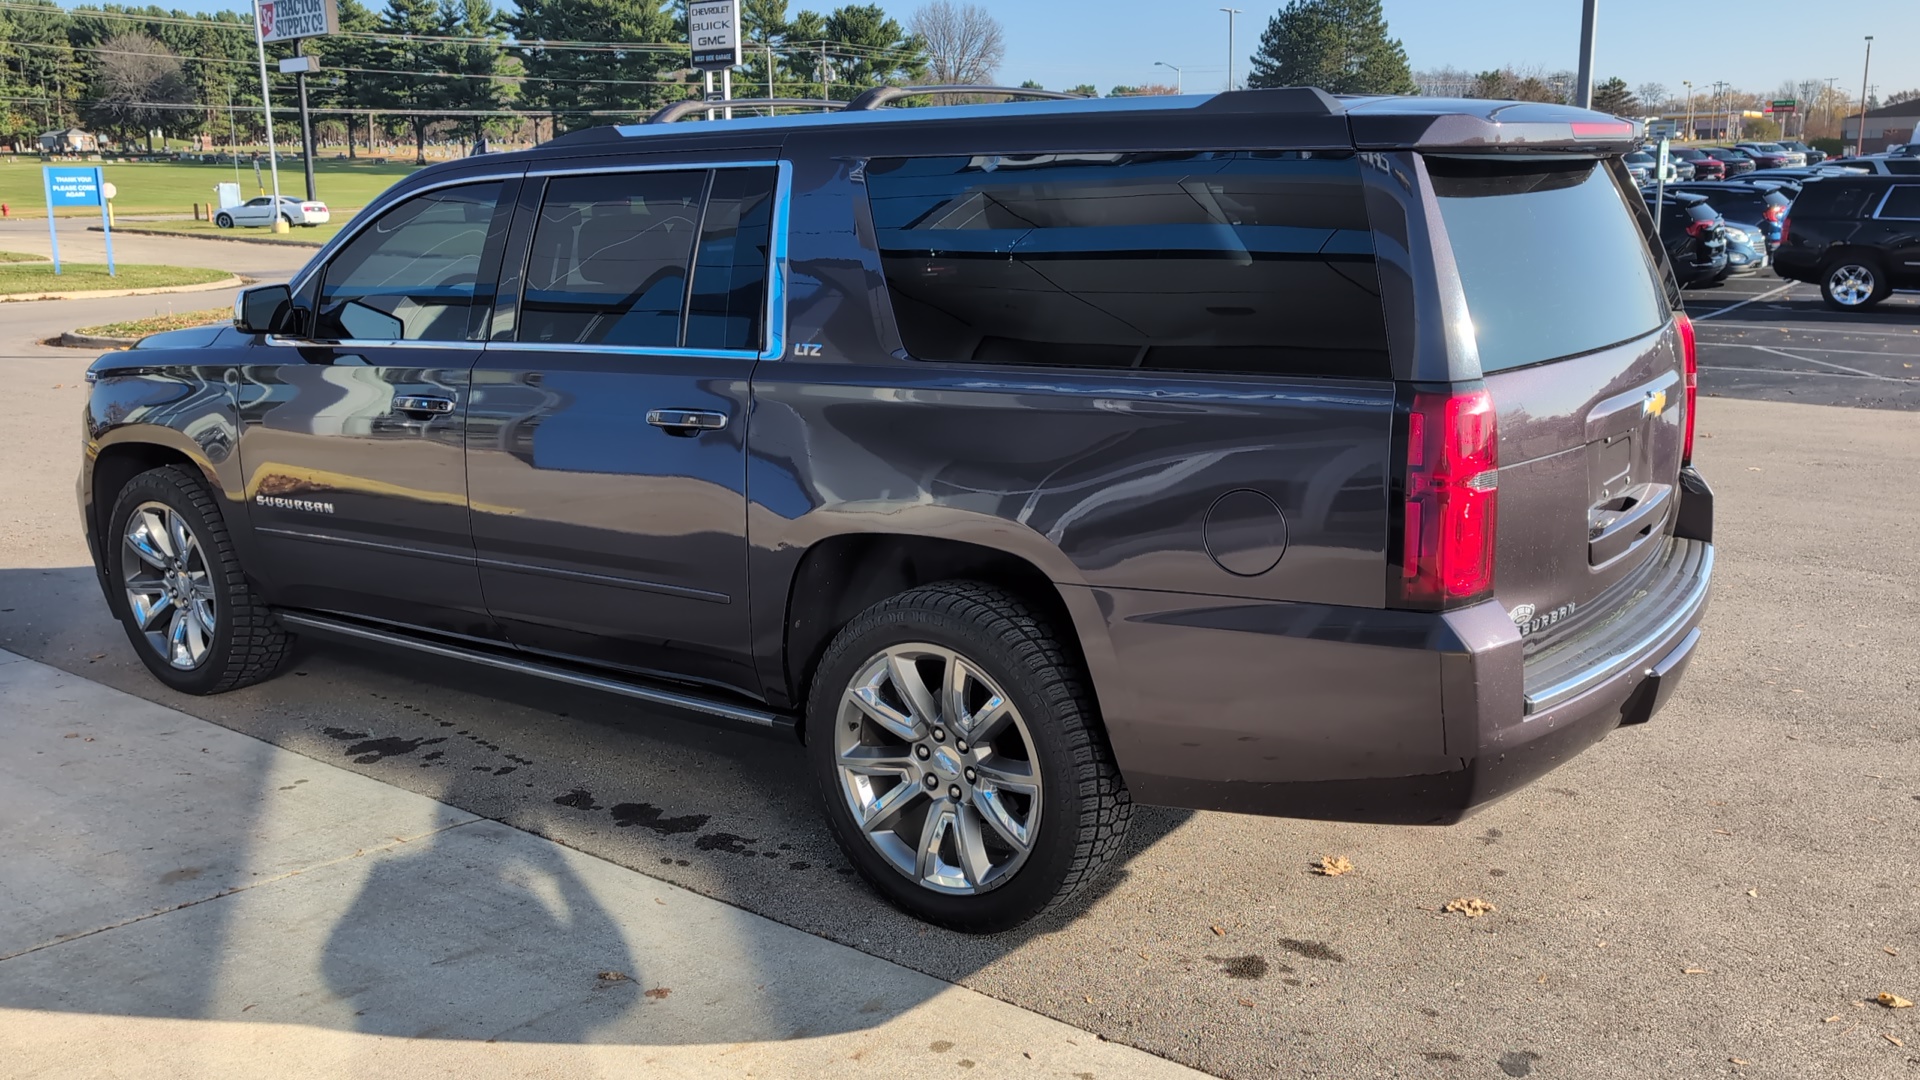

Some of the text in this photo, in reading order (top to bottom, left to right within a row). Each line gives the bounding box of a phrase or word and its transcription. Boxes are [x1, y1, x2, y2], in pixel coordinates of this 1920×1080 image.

[273, 0, 321, 18] TRACTOR
[691, 5, 729, 16] CHEVROLET
[275, 15, 310, 37] SUPPLY
[692, 20, 731, 31] BUICK
[697, 35, 726, 46] GMC
[794, 343, 823, 357] LTZ
[256, 495, 334, 514] SUBURBAN
[1518, 602, 1575, 635] BURBAN
